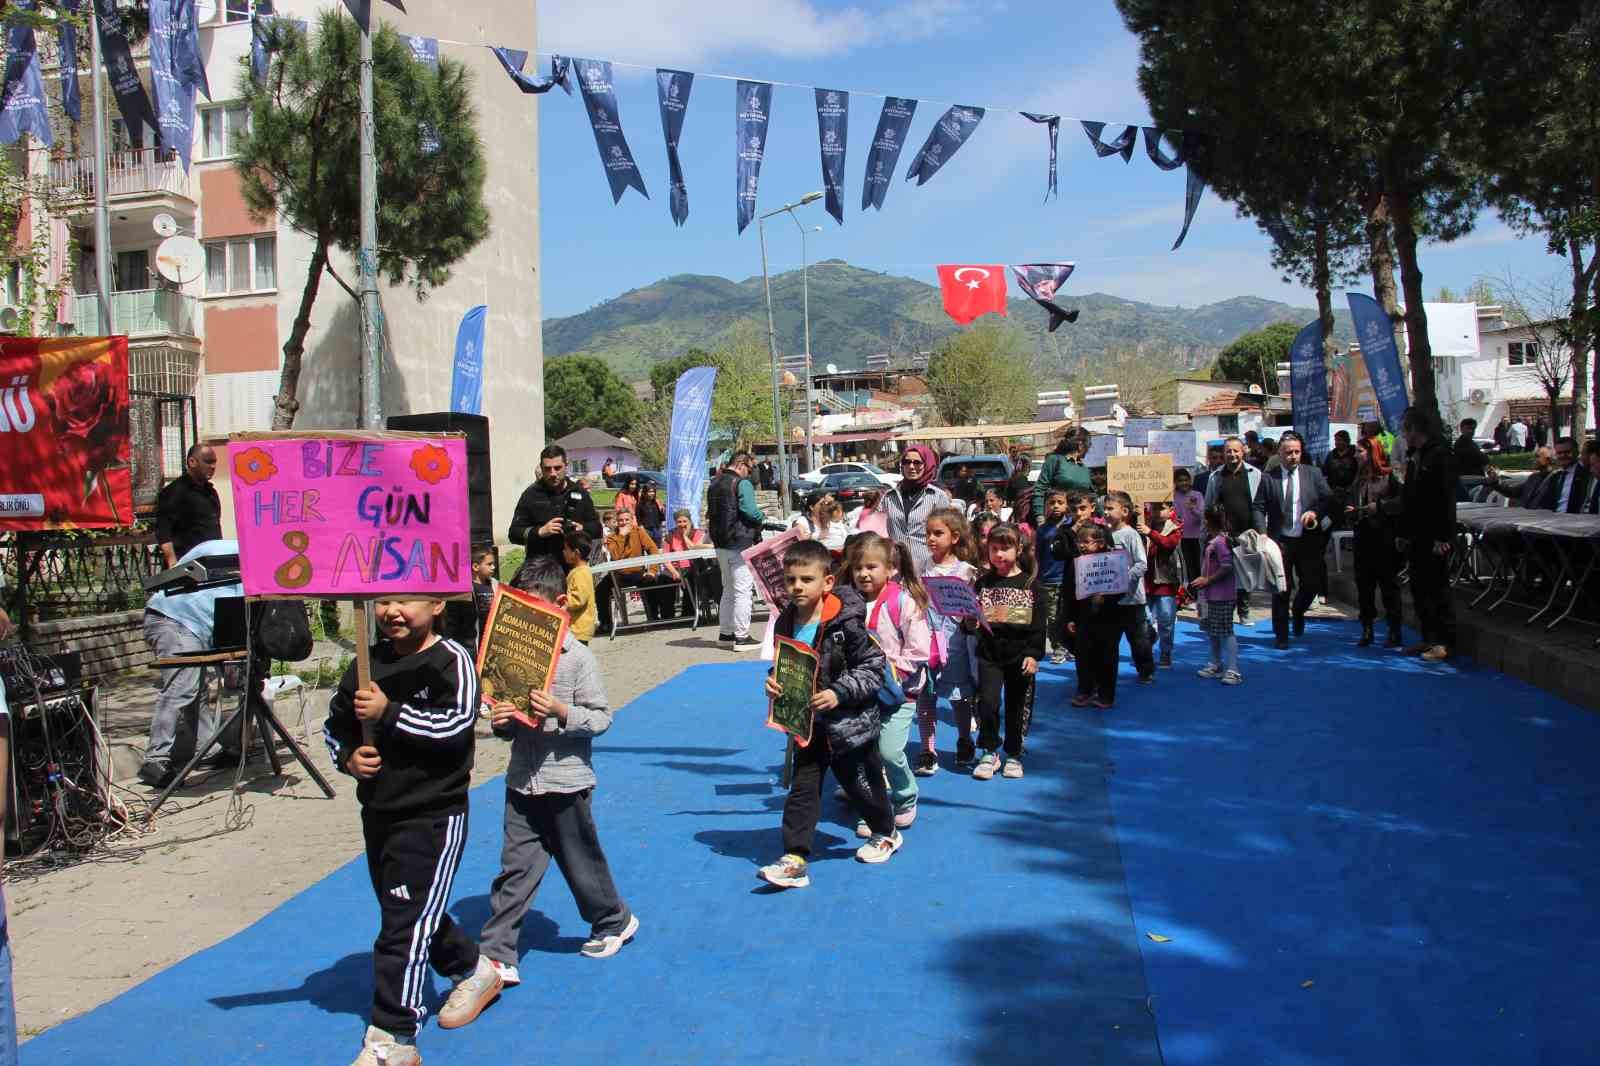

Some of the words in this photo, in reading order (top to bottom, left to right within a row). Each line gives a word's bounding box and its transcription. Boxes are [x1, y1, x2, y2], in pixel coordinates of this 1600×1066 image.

[302, 441, 384, 478] BİZE
[255, 489, 326, 526] HER
[357, 485, 430, 528] GÜN
[275, 531, 313, 589] 8
[331, 531, 460, 587] NİSAN
[502, 614, 528, 630] ROMAN
[528, 623, 554, 643] OLMAK
